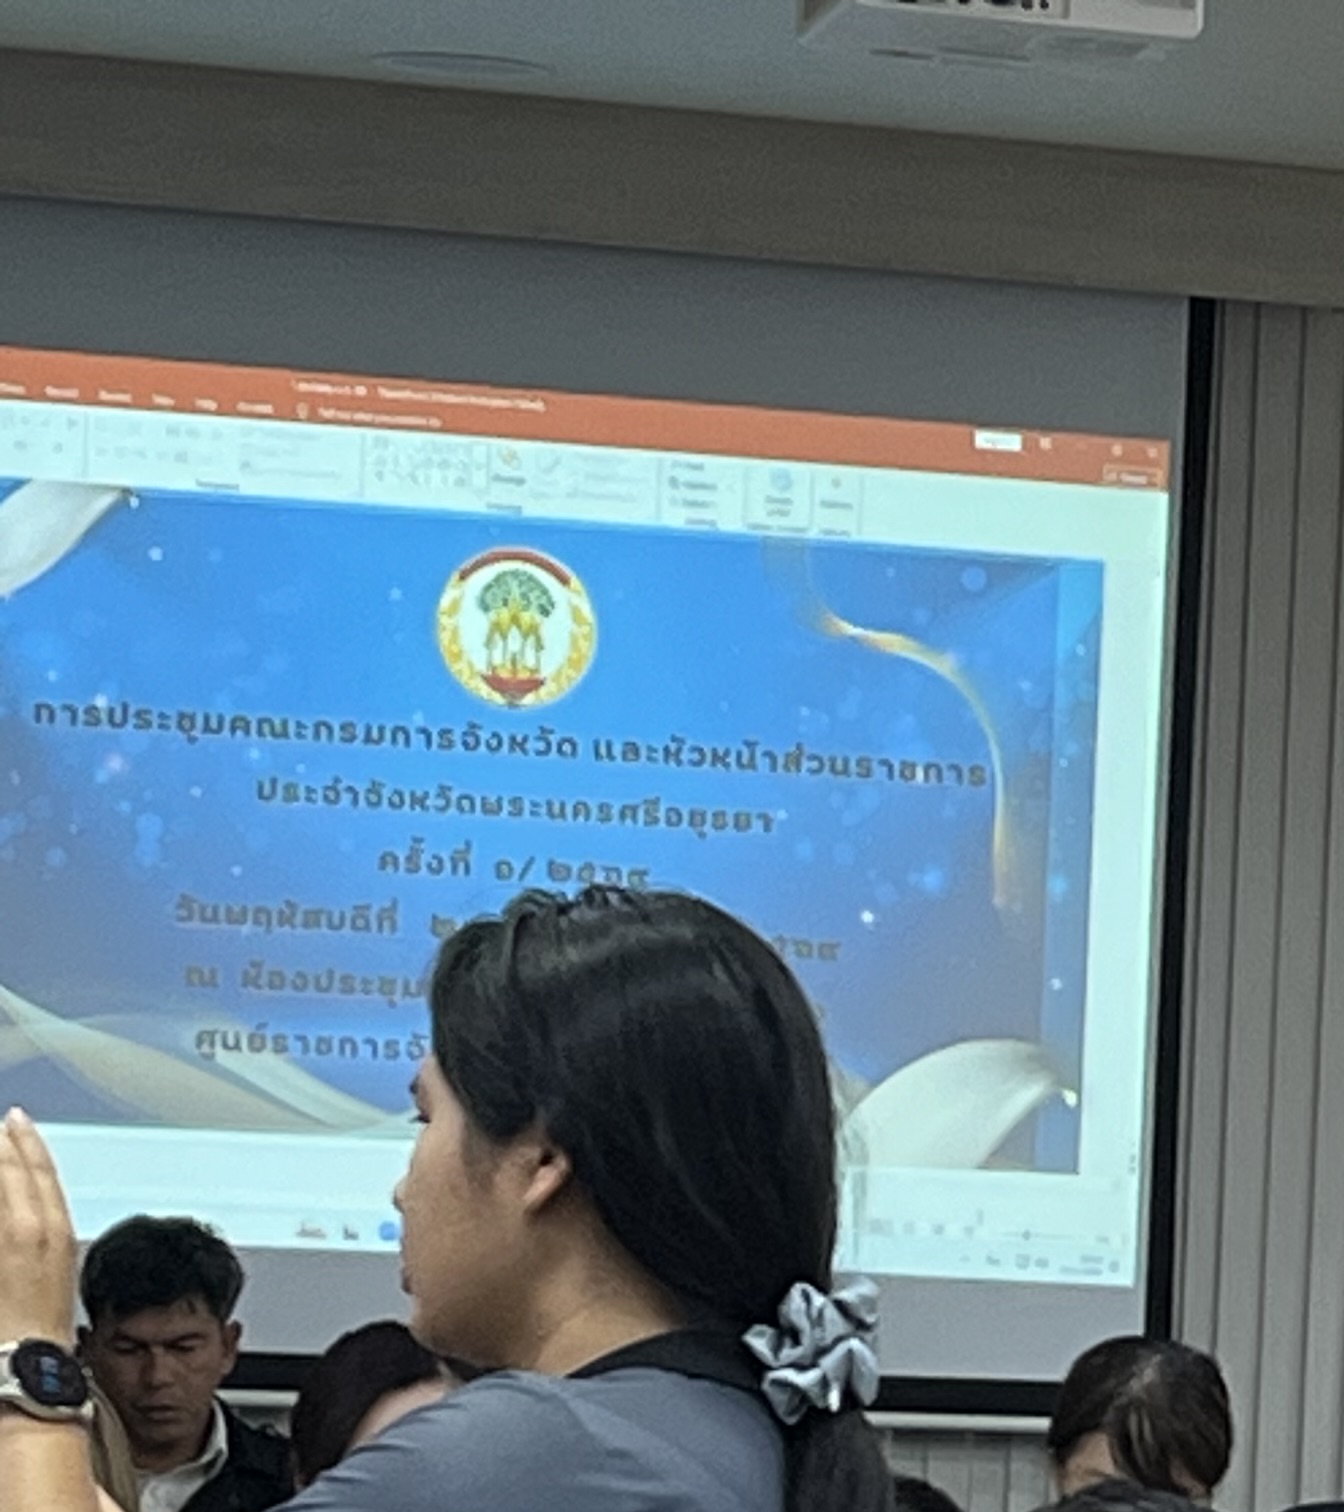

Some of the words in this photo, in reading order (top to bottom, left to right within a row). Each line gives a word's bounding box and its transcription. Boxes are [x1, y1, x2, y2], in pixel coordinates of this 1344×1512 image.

[593, 734, 987, 787] และหัวหน้าส่วนราชการ
[378, 835, 472, 877] ครั้งที่
[175, 893, 399, 935] วันพฤหัสบดีที่
[195, 1022, 430, 1062] ศูนย์ราชการจั
